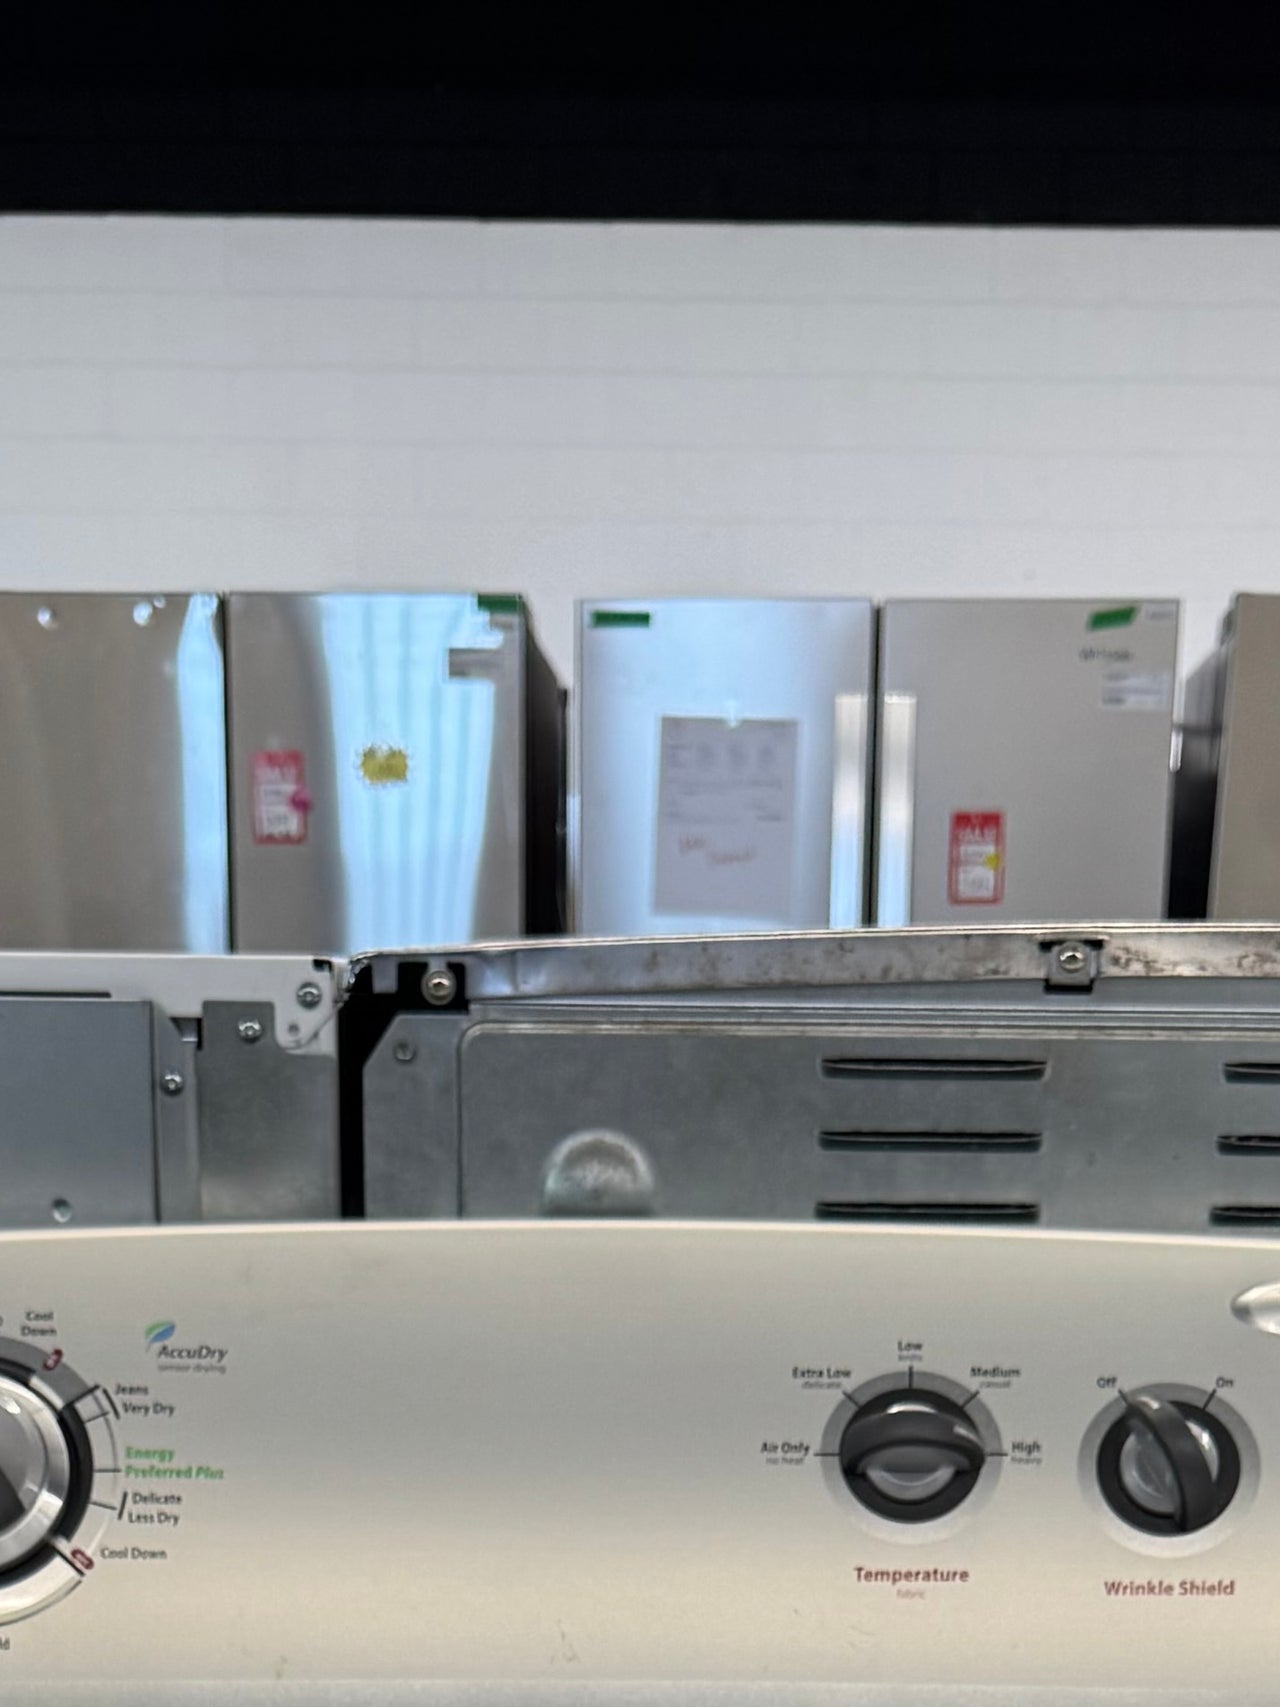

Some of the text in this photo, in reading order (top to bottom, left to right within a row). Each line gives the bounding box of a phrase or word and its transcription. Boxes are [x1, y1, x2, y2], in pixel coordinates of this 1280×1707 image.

[25, 1311, 54, 1322] Cool
[21, 1326, 57, 1337] Down
[158, 1345, 228, 1363] AccuDry
[1097, 1377, 1117, 1389] Off
[1216, 1377, 1234, 1388] On
[122, 1402, 175, 1417] Very Dry
[125, 1447, 175, 1463] Energy
[1012, 1441, 1041, 1456] High
[125, 1466, 225, 1480] Preferred Plus
[132, 1492, 182, 1505] Delicate
[128, 1512, 180, 1526] Less Dry
[100, 1547, 129, 1559] Cool
[132, 1548, 167, 1560] Down
[854, 1566, 970, 1585] Temperature
[1104, 1580, 1236, 1597] Wrinkle Shield
